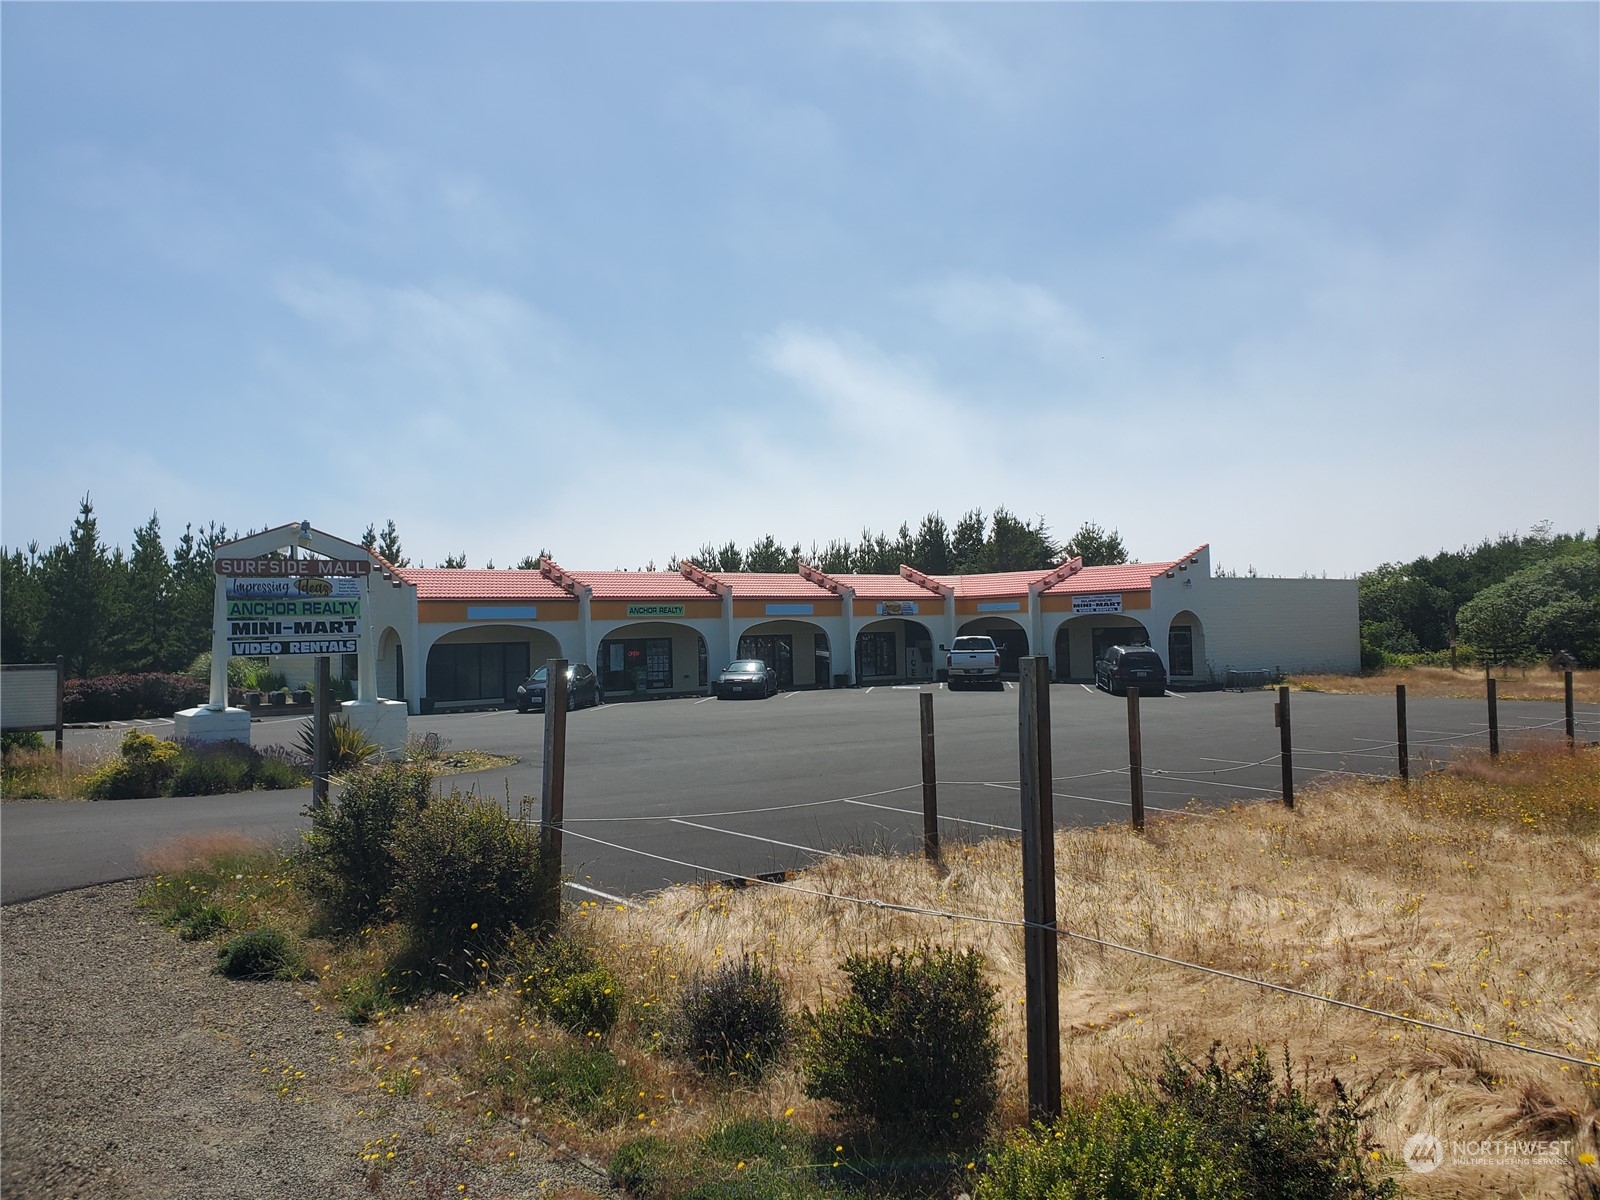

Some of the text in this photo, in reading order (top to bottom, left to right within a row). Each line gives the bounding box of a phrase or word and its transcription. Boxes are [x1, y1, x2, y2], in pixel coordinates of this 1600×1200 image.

[221, 561, 366, 574] SURFSIDE MALL
[233, 579, 291, 596] Impressing
[295, 580, 333, 596] Ideas
[230, 601, 358, 616] ANCHOR REALTY
[659, 606, 683, 614] REALTY
[231, 621, 357, 635] MINI-MART
[234, 641, 356, 655] VIDEO RENTALS
